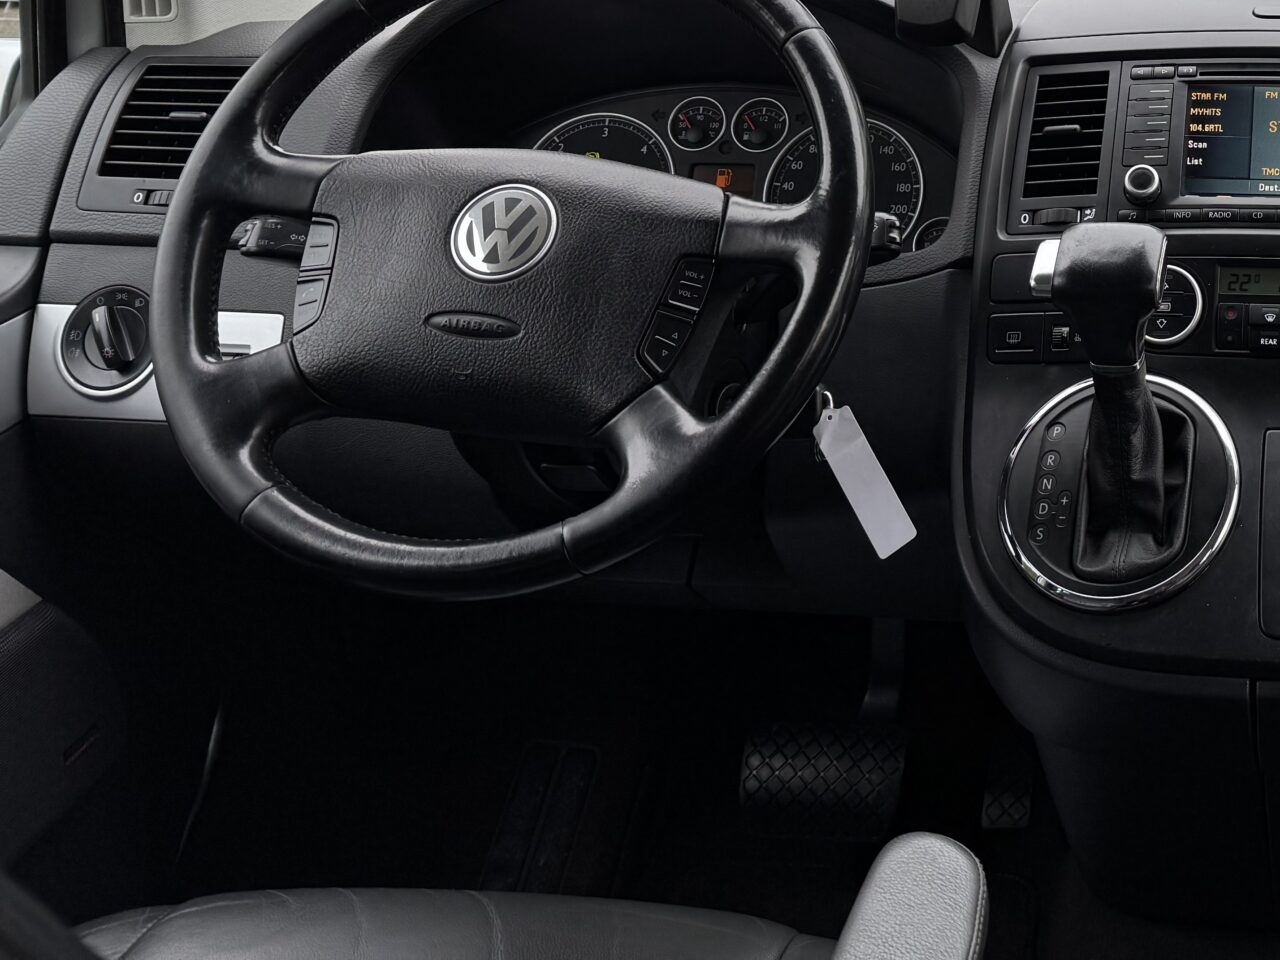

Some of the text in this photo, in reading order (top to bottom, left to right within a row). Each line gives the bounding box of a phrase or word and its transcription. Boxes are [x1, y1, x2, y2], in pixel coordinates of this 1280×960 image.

[1191, 92, 1227, 101] STAR FM
[1265, 91, 1278, 99] FM
[1190, 107, 1221, 116] MYHITS
[602, 128, 609, 137] 3
[1188, 140, 1207, 149] Scan
[640, 145, 647, 154] 4
[879, 145, 894, 154] 140
[791, 161, 803, 169] 60
[1186, 157, 1203, 165] List
[891, 162, 906, 171] 160
[782, 182, 794, 190] 40
[896, 183, 911, 192] 180
[1259, 183, 1280, 192] Dest.
[890, 205, 908, 214] 200
[1173, 211, 1191, 219] INFO
[1208, 211, 1232, 219] RADIO
[1252, 211, 1263, 219] CD
[440, 318, 506, 332] AIRBAG
[1053, 427, 1061, 437] P
[1046, 455, 1055, 466] R
[1042, 478, 1052, 489] N
[1038, 503, 1049, 514] D
[1036, 528, 1044, 539] S
